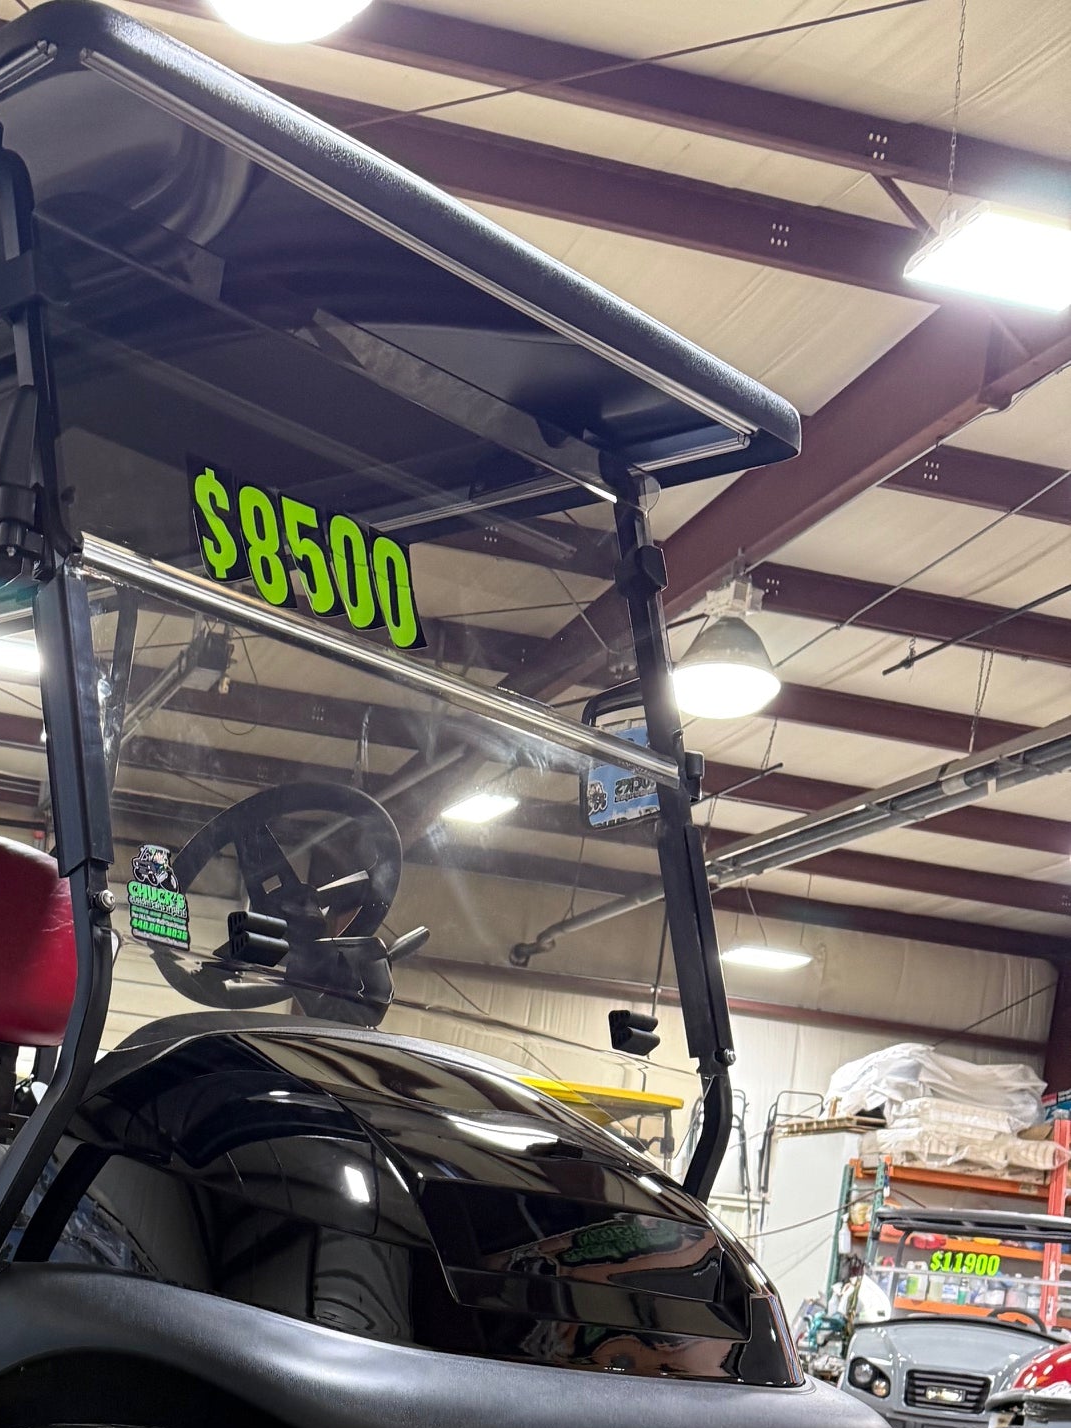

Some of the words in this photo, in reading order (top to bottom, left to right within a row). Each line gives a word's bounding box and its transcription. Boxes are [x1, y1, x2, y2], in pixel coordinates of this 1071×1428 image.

[193, 467, 418, 649] $8500
[128, 881, 186, 909] CHUCK'S
[930, 1251, 1001, 1277] $11900
